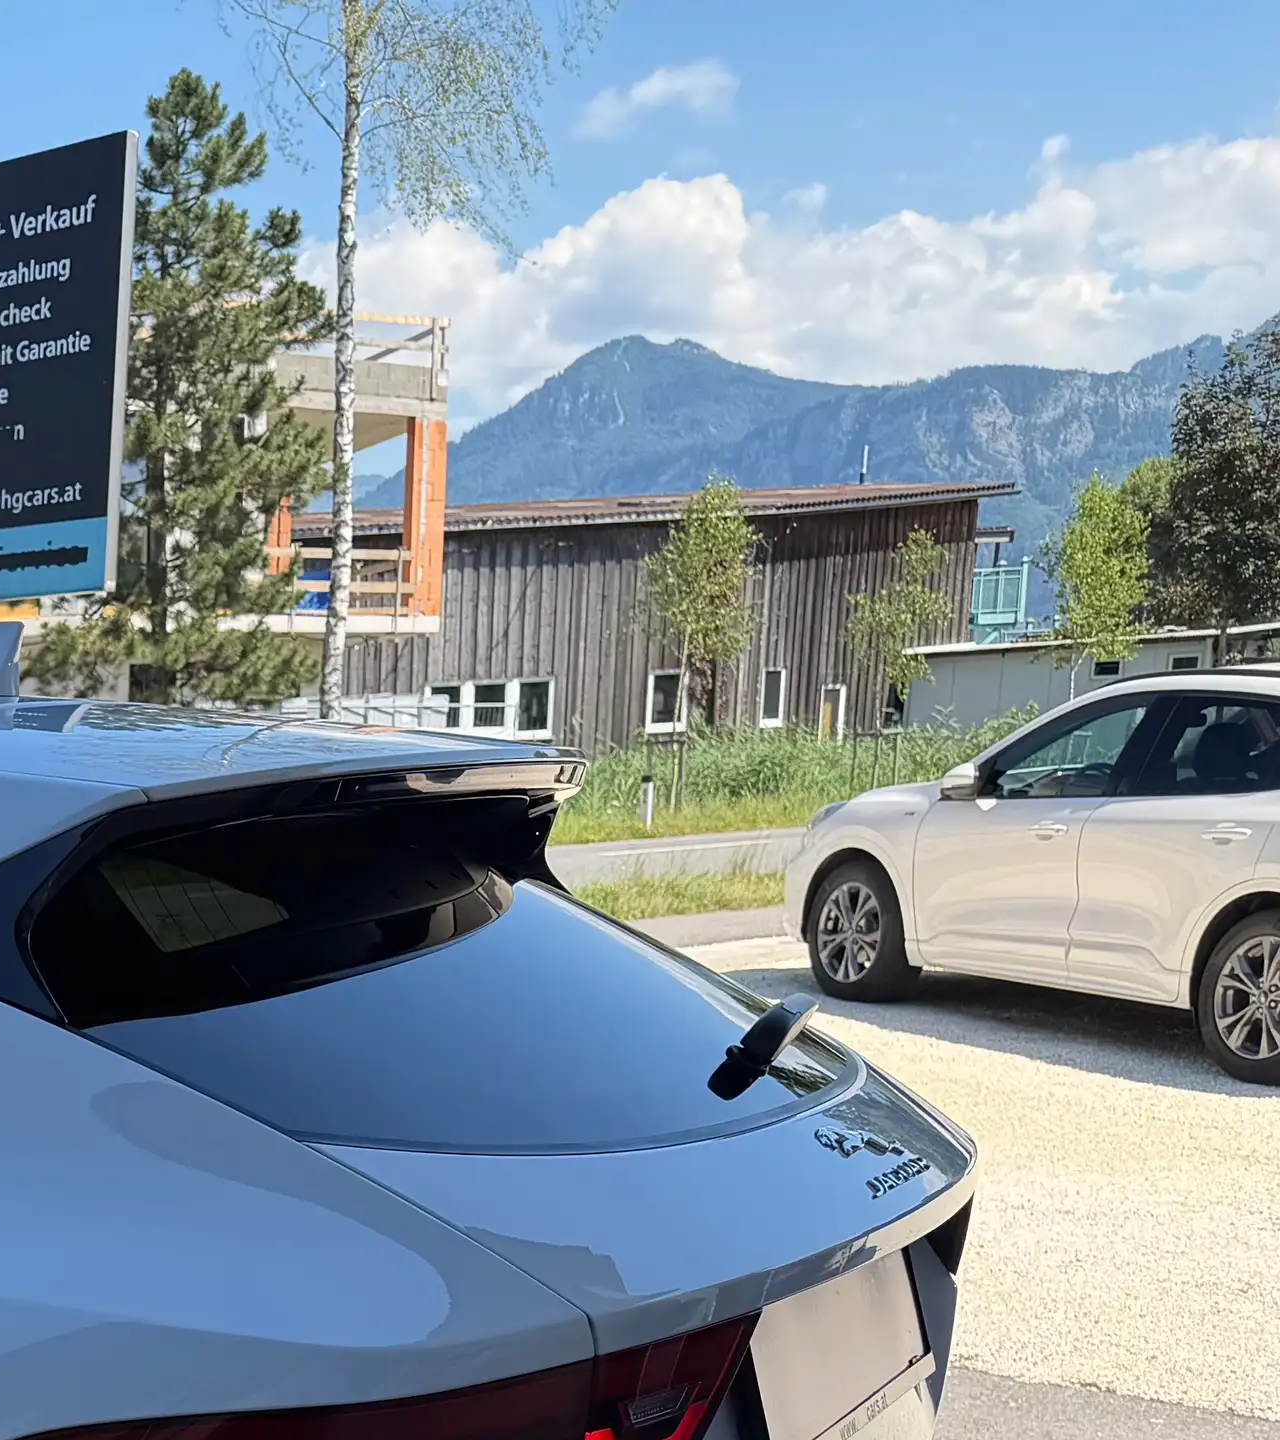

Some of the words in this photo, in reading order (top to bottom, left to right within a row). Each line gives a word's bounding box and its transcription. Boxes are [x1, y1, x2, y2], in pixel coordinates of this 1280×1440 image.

[10, 194, 97, 239] Verkauf
[16, 330, 91, 362] Garantie
[865, 1157, 931, 1200] JAGUAR
